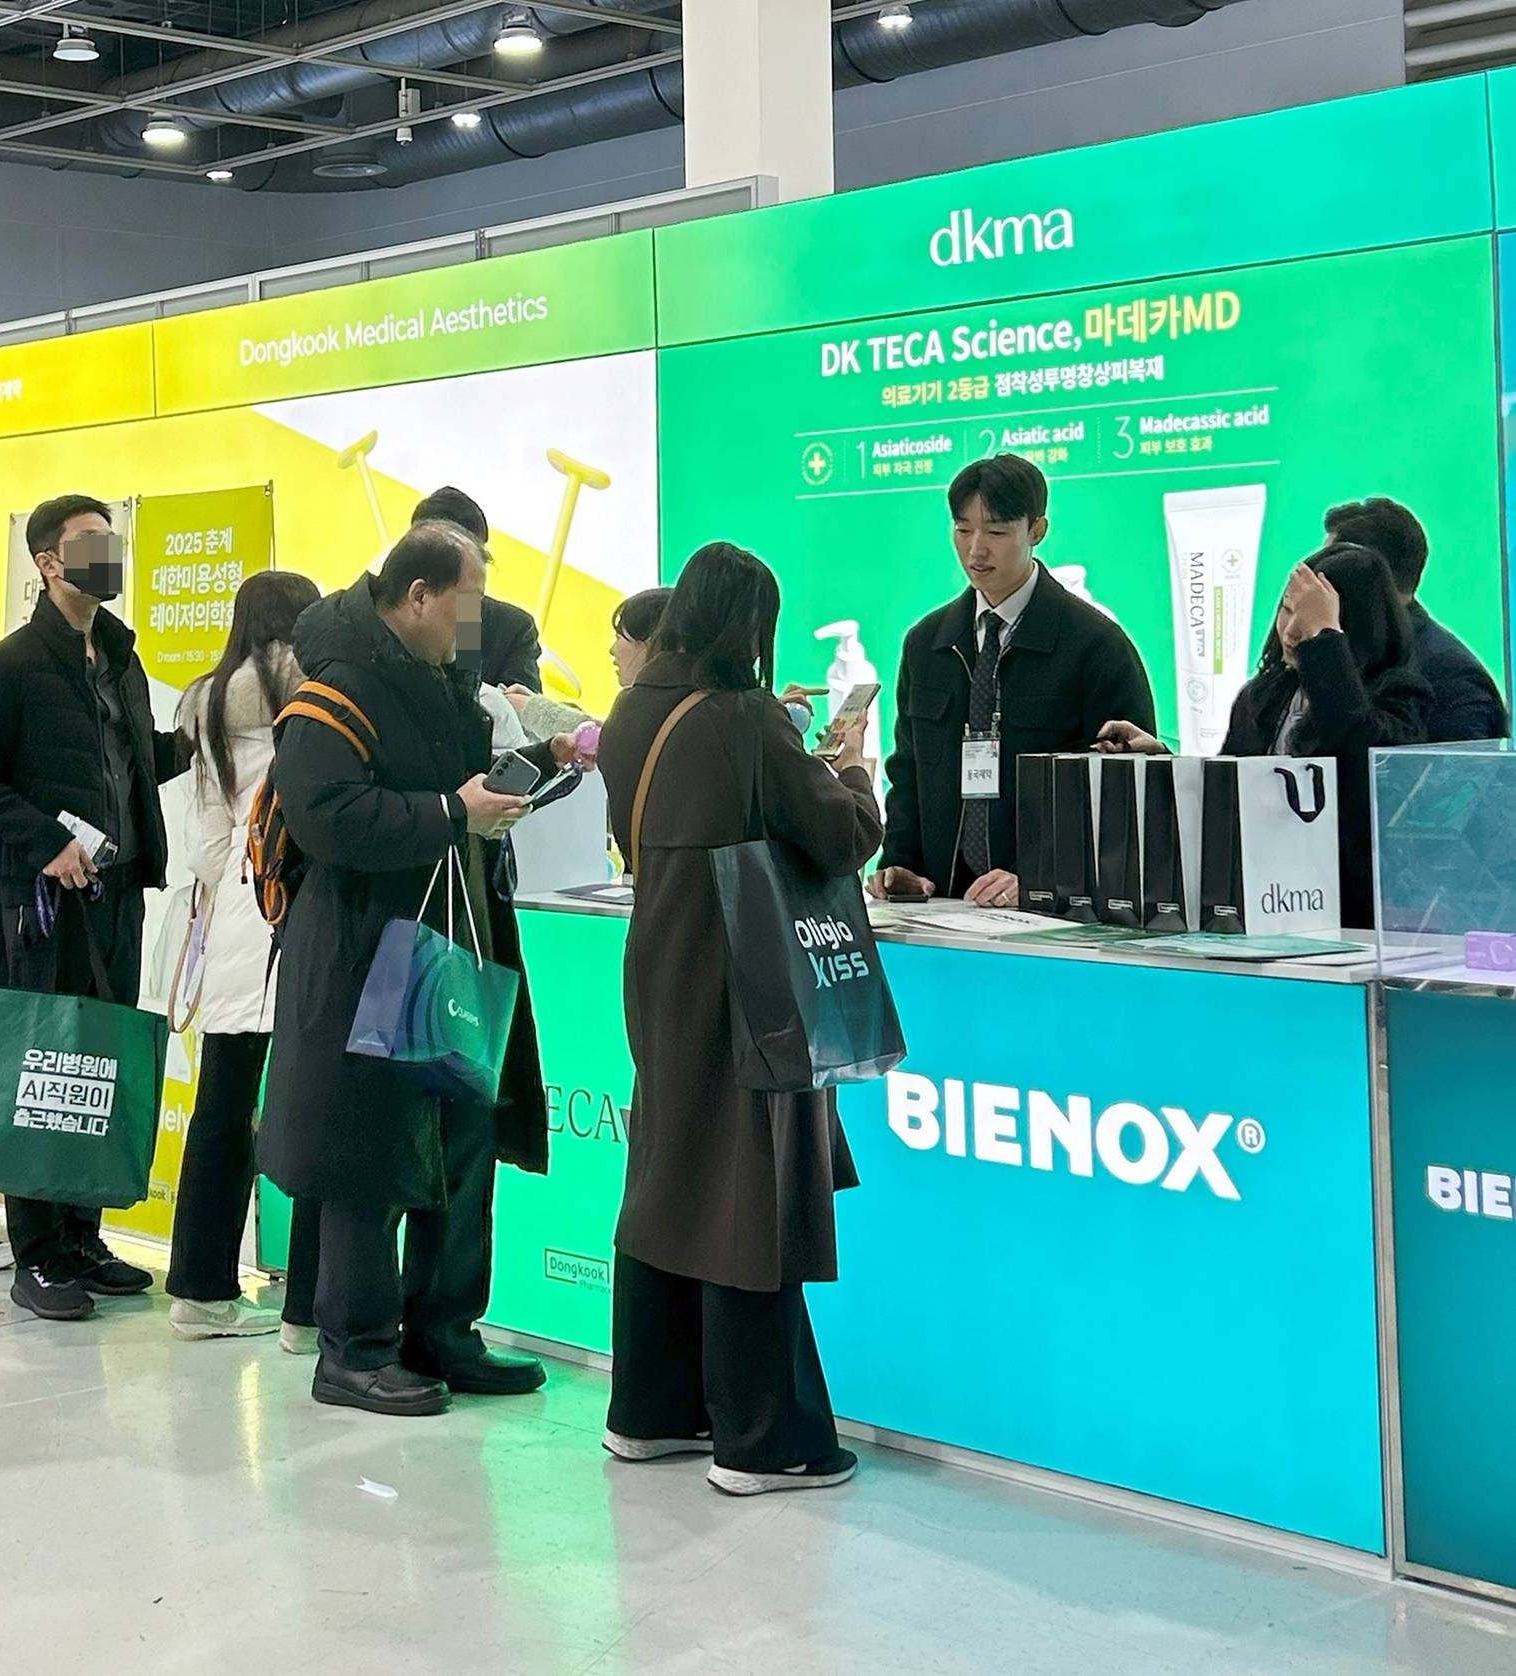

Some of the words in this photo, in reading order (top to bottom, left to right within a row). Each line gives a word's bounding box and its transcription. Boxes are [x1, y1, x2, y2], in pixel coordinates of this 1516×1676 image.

[930, 206, 1074, 267] dkma
[240, 325, 340, 367] Dongkook
[344, 308, 424, 350] Medical
[430, 291, 548, 335] Aesthetics
[821, 340, 862, 377] DK
[867, 330, 945, 372] TECA
[951, 318, 1082, 362] Science,
[1085, 290, 1241, 347] 마데카MD
[881, 380, 943, 408] 의료기기
[947, 375, 990, 401] 2등급
[995, 354, 1165, 397] 점착성투명창상피복재
[1001, 424, 1050, 448] Asiatic
[1052, 421, 1085, 442] acid
[1113, 416, 1134, 459] 3
[1140, 408, 1231, 435] Madecassic
[1234, 404, 1270, 426] acid
[856, 441, 865, 479] 1
[872, 434, 953, 458] Asiaticoside
[165, 532, 203, 556] 2025
[205, 527, 233, 555] 춘계
[151, 560, 244, 596] 대한미용성형
[1189, 551, 1206, 628] MADECA
[1261, 884, 1325, 914] dkma
[795, 915, 854, 951] Oligio
[22, 1048, 118, 1081] 우리병원에
[21, 1079, 110, 1110] AI직원이
[545, 1085, 622, 1143] ECA
[12, 1108, 109, 1137] 출근했습니다
[1426, 1164, 1516, 1220] BIE
[549, 1256, 606, 1282] Dongkook
